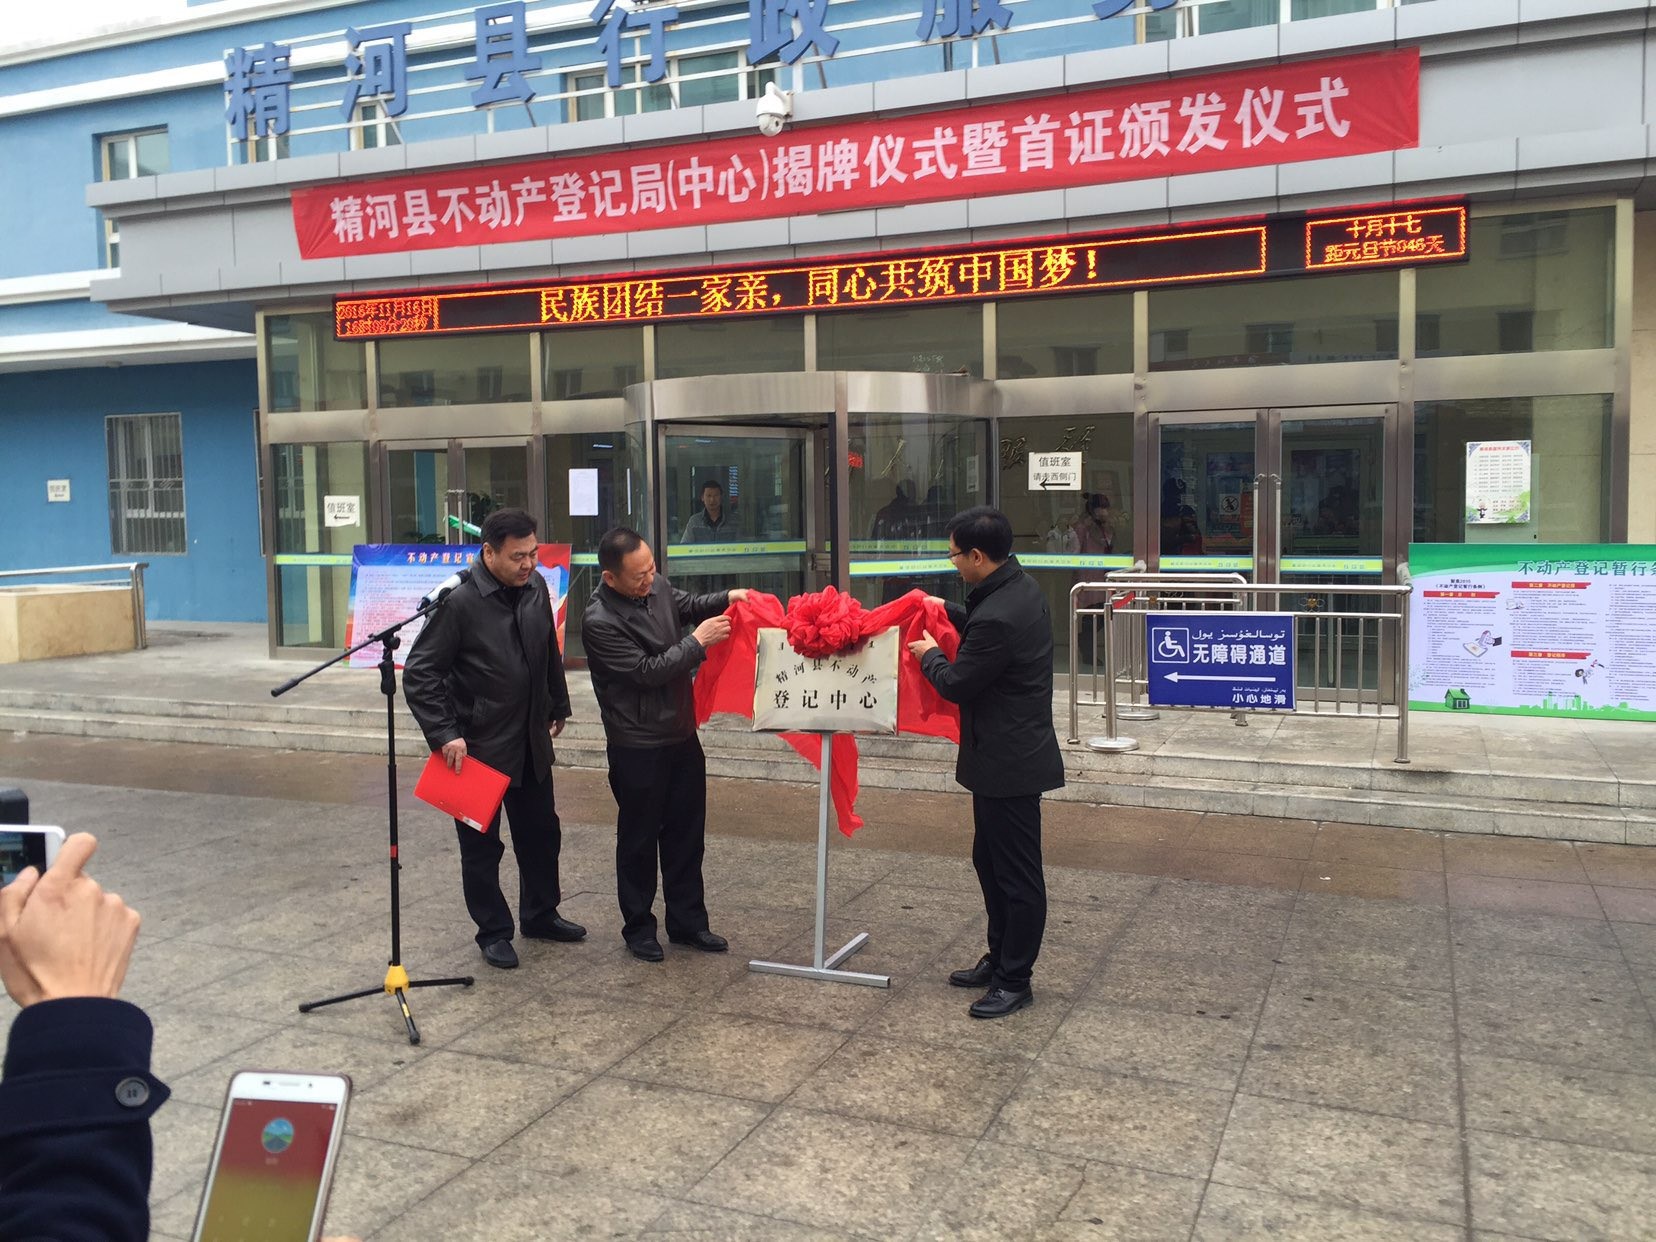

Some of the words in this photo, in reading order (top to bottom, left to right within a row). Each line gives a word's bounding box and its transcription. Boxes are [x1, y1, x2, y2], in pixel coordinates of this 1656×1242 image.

[331, 76, 1351, 245] 精河县不动产登记局(中心)揭牌仪式暨首证颁发仪式
[1346, 214, 1422, 238] 十月十七
[1323, 235, 1445, 262] 距元旦节046天
[540, 248, 1099, 323] 民族团结一家亲,同心共筑中国梦!
[1039, 456, 1071, 467] 值班室
[1033, 472, 1076, 481] 请走西侧门
[327, 502, 356, 513] 值班室
[1192, 629, 1213, 641] يول
[1193, 644, 1286, 665] 无障碍通道
[776, 658, 877, 684] 精河县不动产
[774, 690, 877, 710] 登记中心
[1232, 694, 1286, 704] 小心地滑
